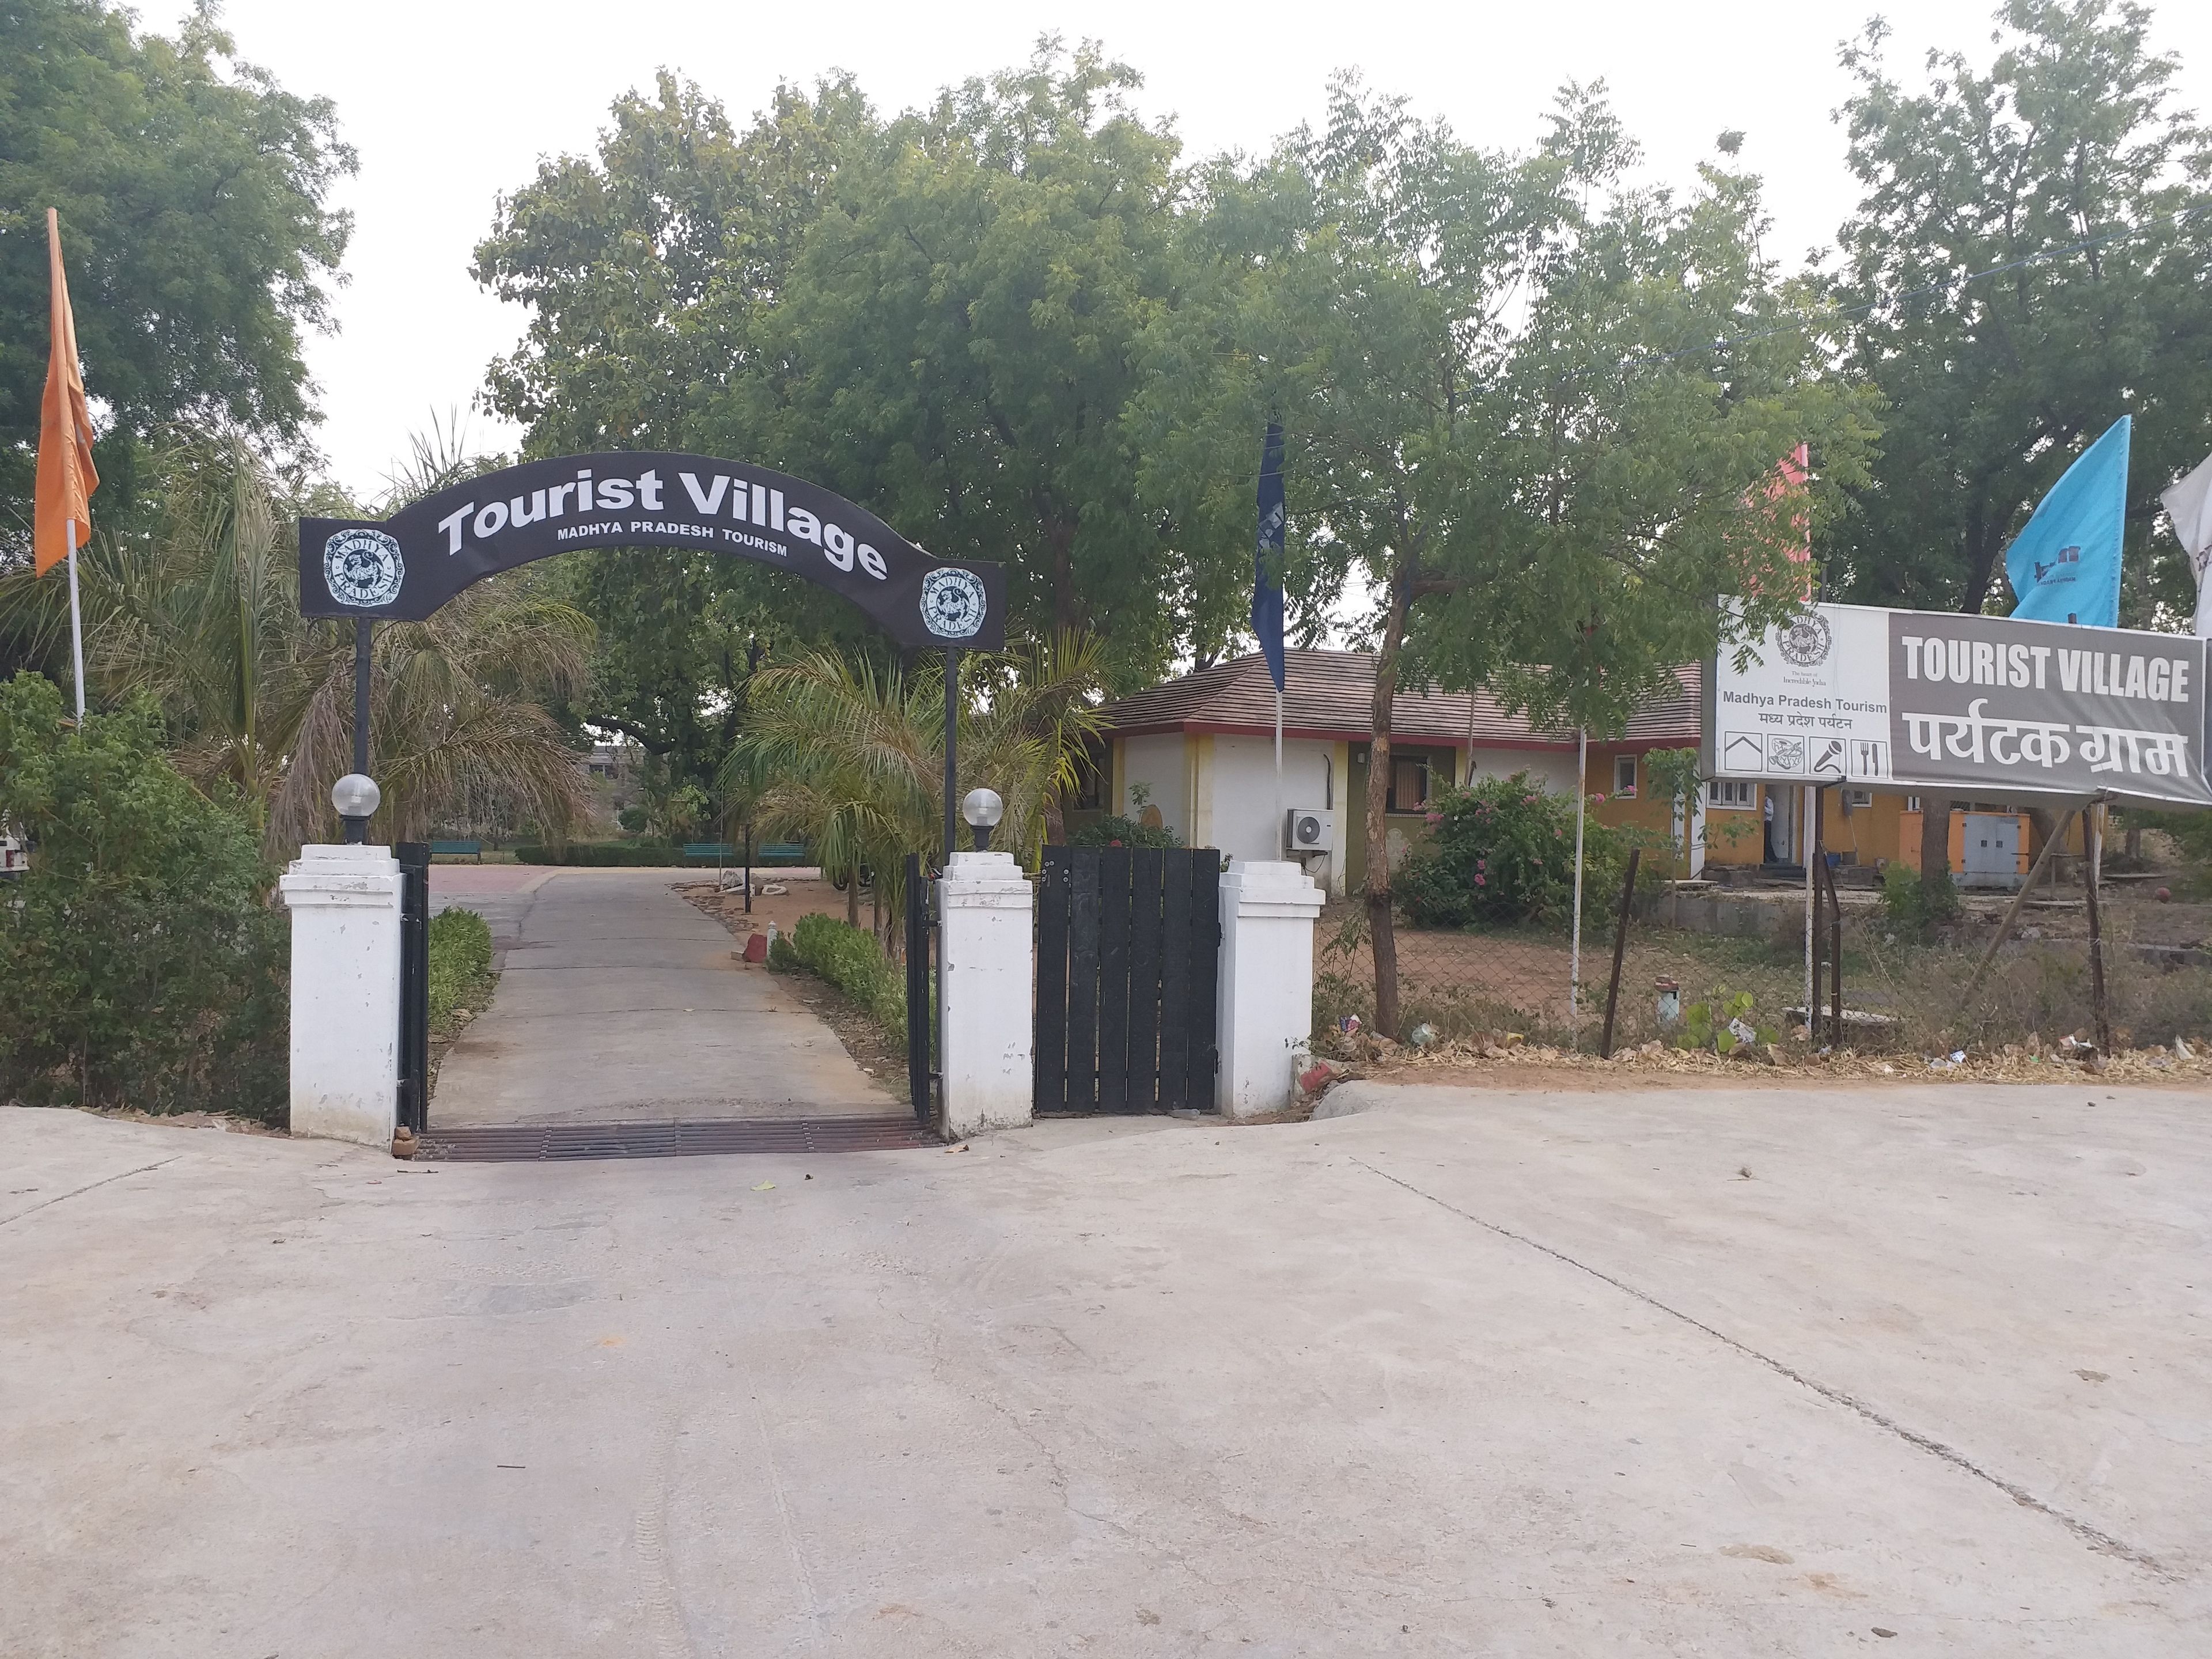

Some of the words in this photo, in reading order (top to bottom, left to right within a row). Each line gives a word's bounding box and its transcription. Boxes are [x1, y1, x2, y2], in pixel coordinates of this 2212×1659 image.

[438, 469, 664, 556] Tourist
[678, 472, 888, 580] Village
[558, 521, 623, 540] MADHYA
[631, 521, 714, 538] PRADESH
[722, 528, 787, 557] TOURISM
[335, 540, 389, 562] MADHYA
[334, 573, 393, 598] PRADESH
[930, 577, 974, 598] MADHYA
[929, 606, 976, 630] PRADESH
[1783, 641, 1824, 661] PRADESH
[1783, 676, 1812, 684] Incredible
[1902, 635, 2051, 689] TOURIST
[2058, 648, 2189, 702] VILLAGE
[1723, 691, 1774, 707] Madhya
[1779, 695, 1831, 709] Pradesh
[1836, 699, 1887, 713] Tourism
[1758, 713, 1784, 725] मध्य
[1787, 711, 1815, 728] प्रदेश
[1818, 713, 1853, 729] पर्यटन
[1902, 698, 2070, 768] पर्यटक
[2075, 725, 2188, 778] ग्राम
